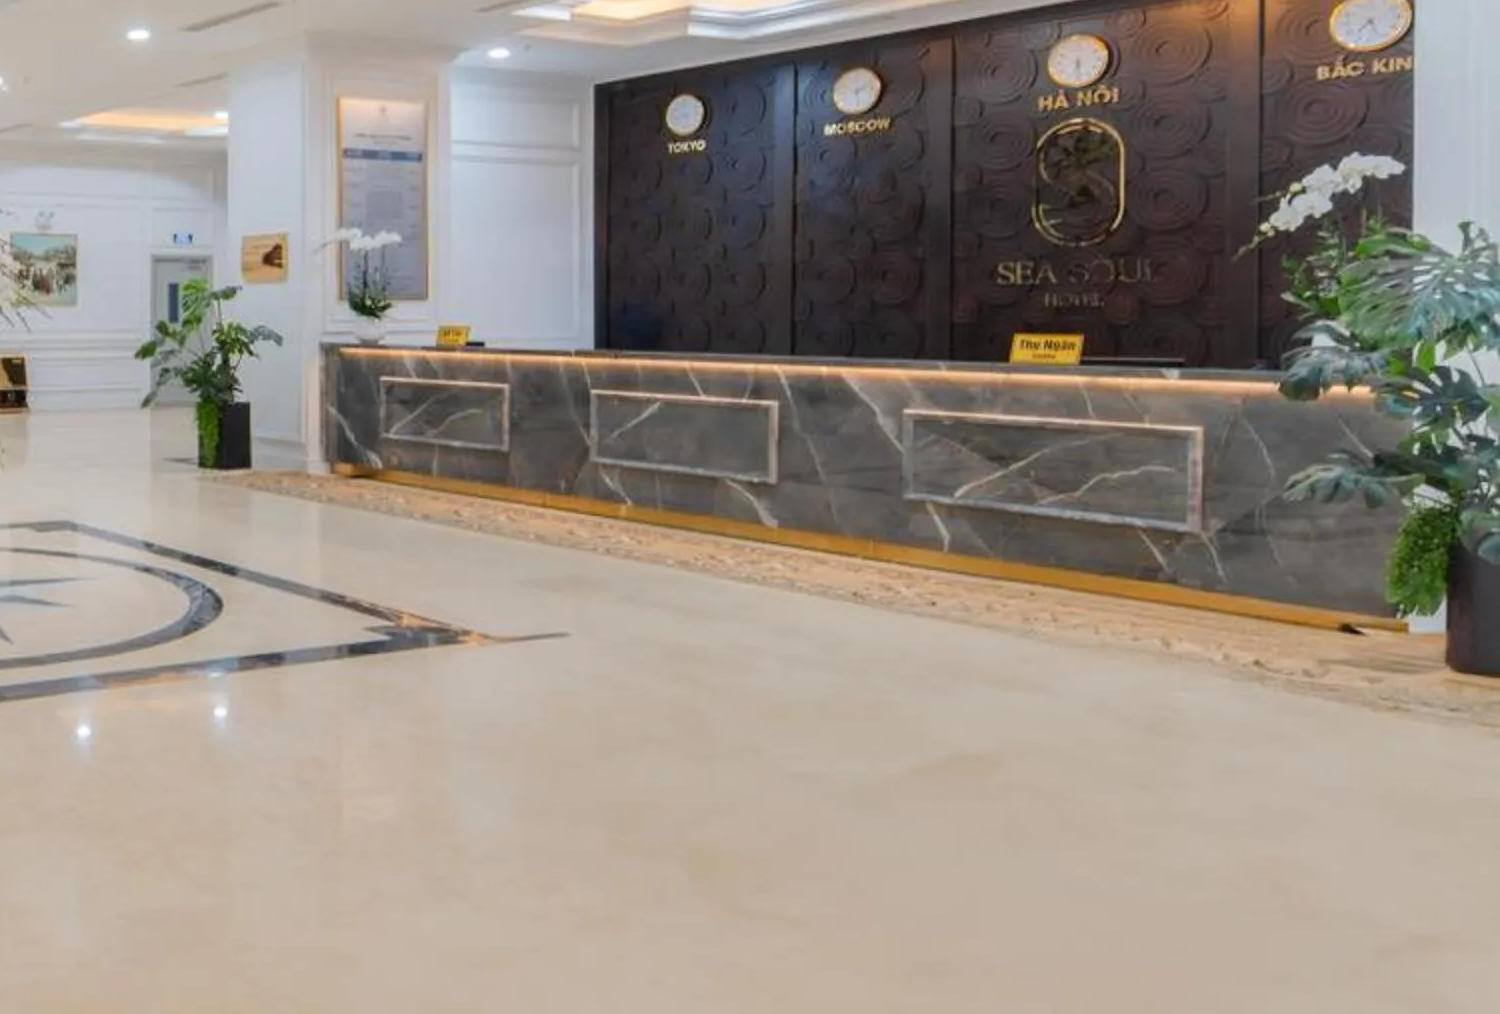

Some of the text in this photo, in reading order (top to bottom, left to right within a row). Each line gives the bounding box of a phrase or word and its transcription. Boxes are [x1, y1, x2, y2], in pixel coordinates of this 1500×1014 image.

[1371, 55, 1413, 75] KIN
[823, 117, 891, 136] MOSCOW
[668, 139, 707, 154] TOKYO
[996, 260, 1058, 285] SEA
